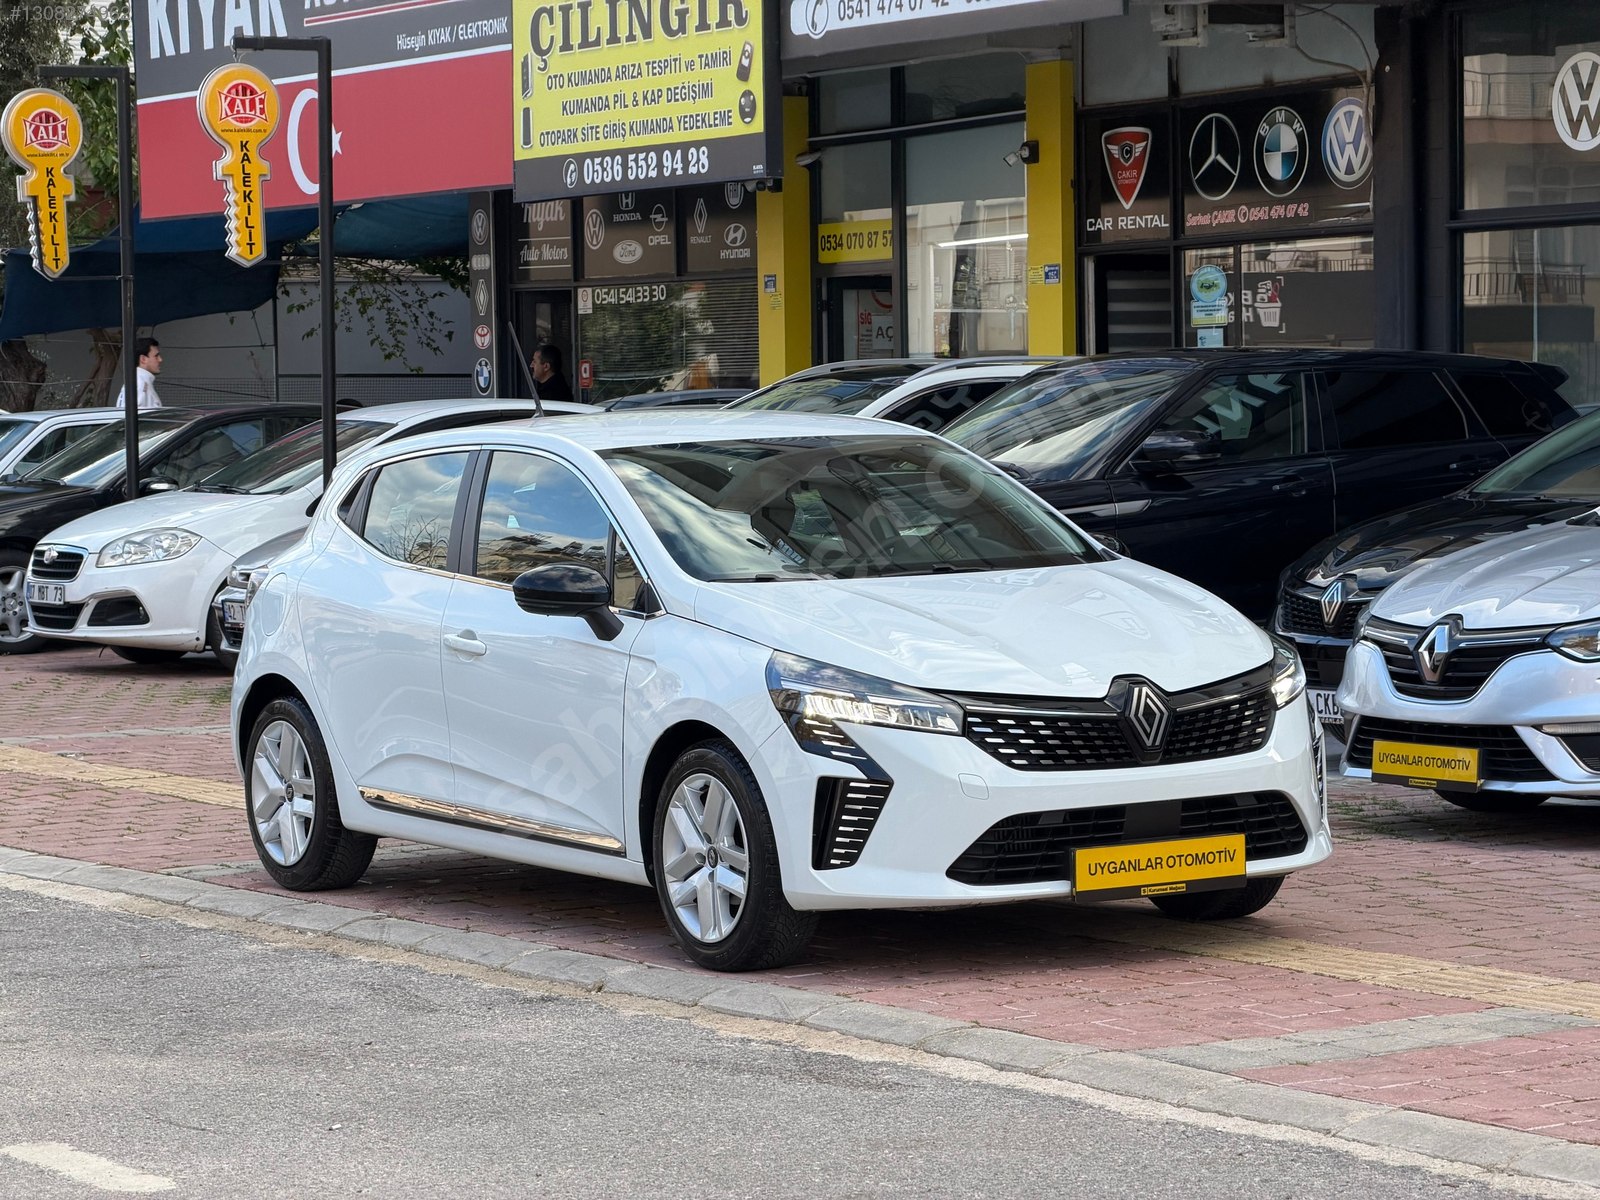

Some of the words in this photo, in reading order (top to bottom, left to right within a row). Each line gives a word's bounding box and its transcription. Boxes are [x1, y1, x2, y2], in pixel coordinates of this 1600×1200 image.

[397, 31, 426, 52] Hüseyin
[428, 26, 451, 46] KIYAK
[547, 74, 564, 90] OTO
[567, 68, 612, 87] KUMANDA
[615, 63, 642, 81] ARIZA
[645, 53, 681, 77] TESPİTİ
[685, 59, 695, 72] ve
[698, 46, 731, 70] TAMİRİ
[221, 93, 267, 119] KALE
[562, 95, 610, 116] KUMANDA
[613, 90, 628, 110] PİL
[632, 94, 639, 106] &
[643, 88, 662, 105] KAP
[666, 78, 713, 104] DEĞİŞİMİ
[25, 121, 68, 145] KALE
[540, 127, 578, 147] OTOPARK
[581, 123, 600, 140] SİTE
[603, 119, 626, 143] GİRİŞ
[629, 116, 674, 137] KUMANDA
[677, 109, 732, 132] YEDEKLEME
[584, 155, 622, 184] 0536
[628, 151, 657, 180] 552
[663, 149, 683, 177] 94
[688, 146, 709, 174] 28
[613, 212, 642, 222] HONDA
[1087, 218, 1112, 231] CAR
[1118, 214, 1169, 229] RENTAL
[1249, 207, 1268, 221] 0541
[648, 235, 671, 246] OPEL
[690, 235, 711, 244] RENAULT
[820, 234, 843, 252] 0534
[846, 232, 864, 250] 070
[867, 231, 879, 249] 87
[520, 244, 540, 263] Auto
[541, 243, 568, 260] Motors
[720, 248, 750, 260] HYUNDAI
[595, 288, 617, 304] 0541
[652, 285, 666, 301] 30
[1378, 752, 1422, 767] UYGANLAR
[1424, 756, 1471, 771] OTOMOTİV
[1088, 856, 1163, 877] UYGANLAR
[1166, 847, 1237, 869] OTOMOTİV
